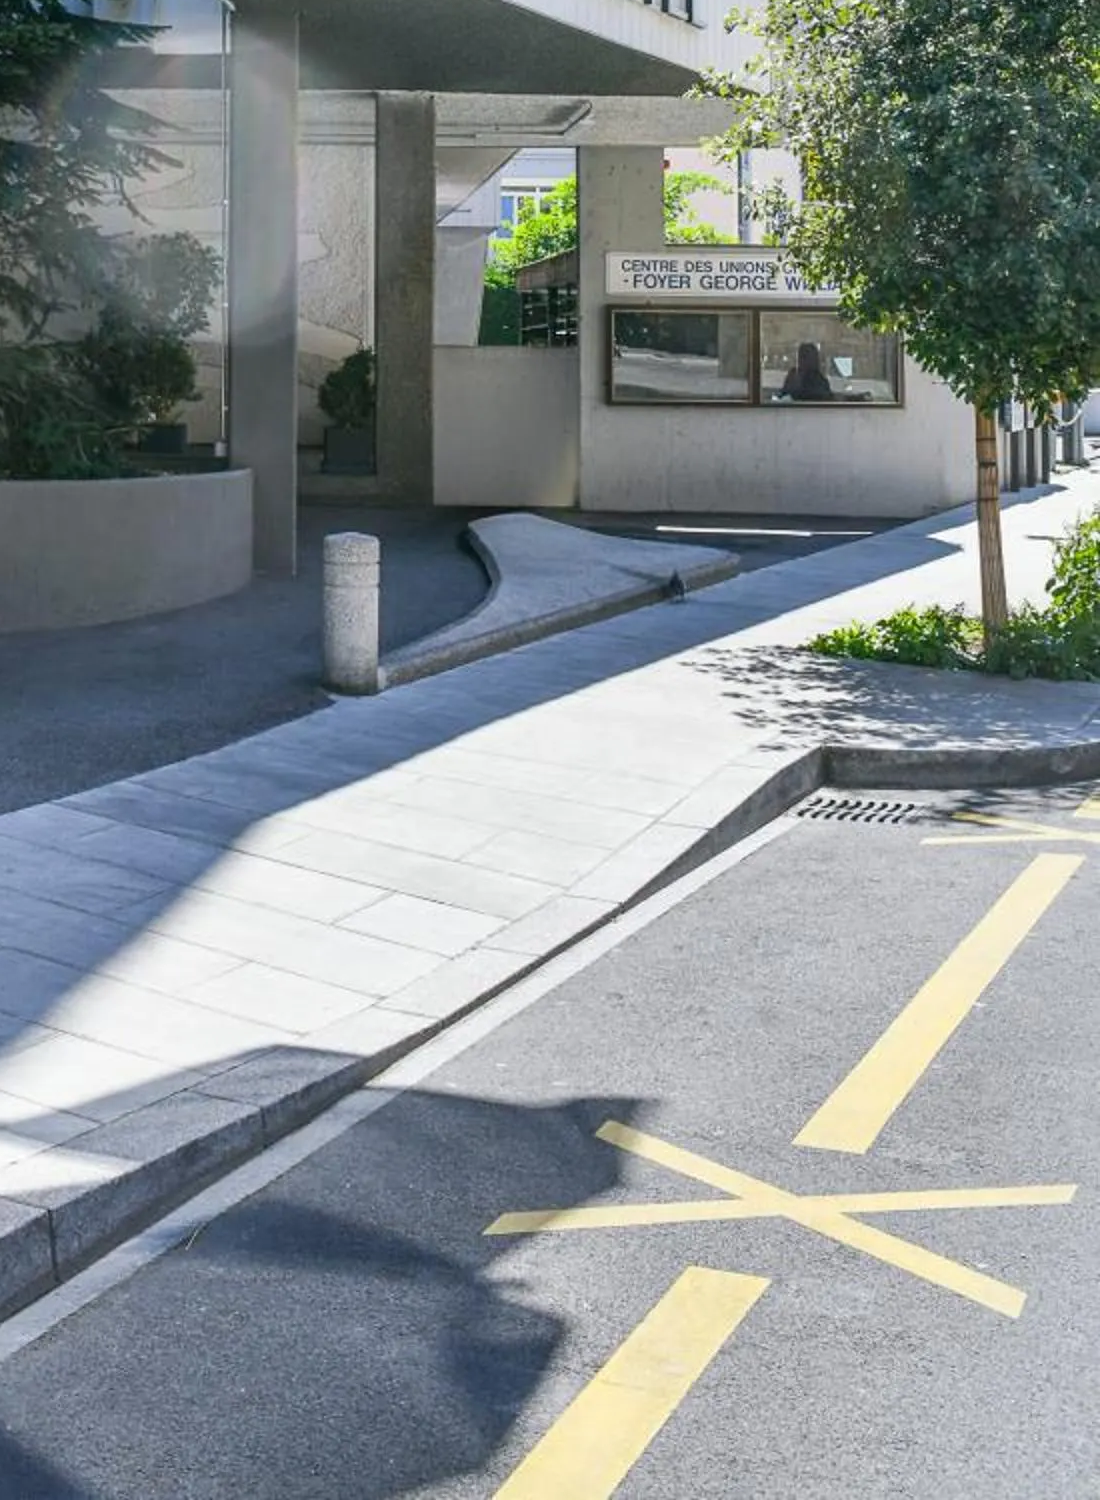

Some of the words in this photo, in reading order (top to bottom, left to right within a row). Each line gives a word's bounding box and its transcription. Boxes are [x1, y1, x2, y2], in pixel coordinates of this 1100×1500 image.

[620, 259, 679, 274] CENTRE
[683, 260, 714, 274] DES
[719, 260, 774, 275] UNIONS
[632, 274, 691, 289] FOYER
[699, 274, 777, 291] GEORGE
